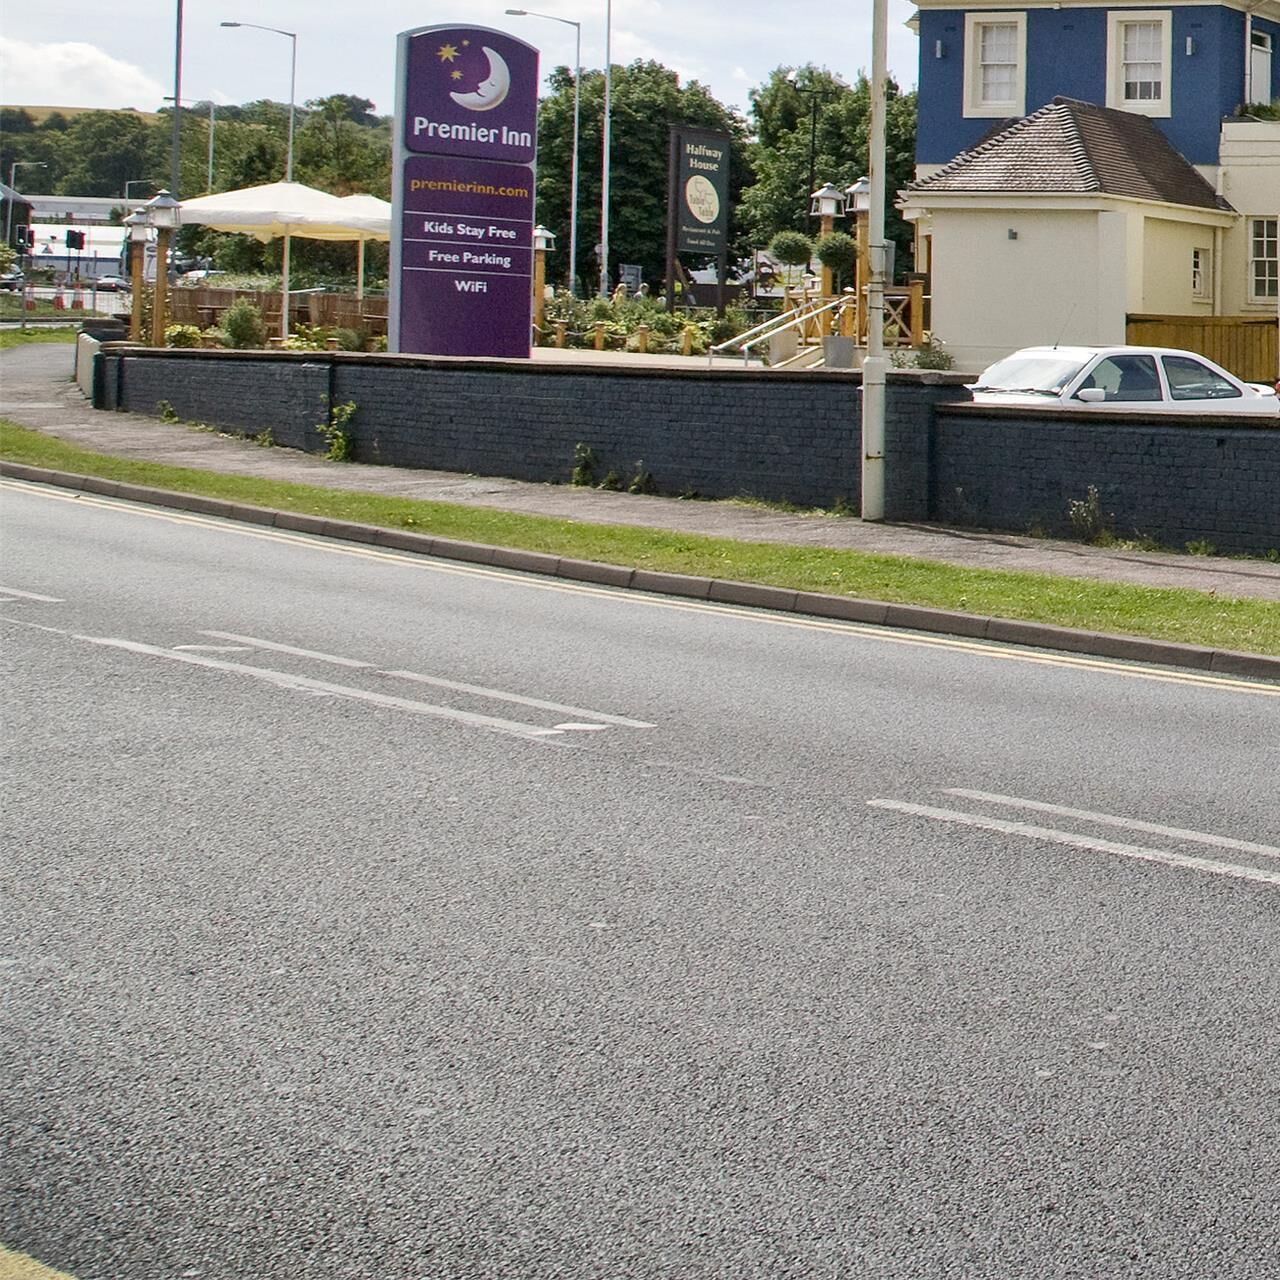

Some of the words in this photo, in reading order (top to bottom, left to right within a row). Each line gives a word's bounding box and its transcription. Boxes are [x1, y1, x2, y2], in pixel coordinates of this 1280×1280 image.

[413, 116, 499, 143] Premier
[501, 126, 531, 147] Inn
[686, 143, 723, 161] Halfway
[690, 157, 719, 171] House
[410, 179, 528, 198] premierinn.com
[424, 221, 454, 234] Kids
[457, 223, 485, 238] Stay
[488, 226, 517, 239] Free
[428, 250, 460, 263] Free
[463, 252, 511, 269] Parking
[455, 280, 487, 293] WiFi
